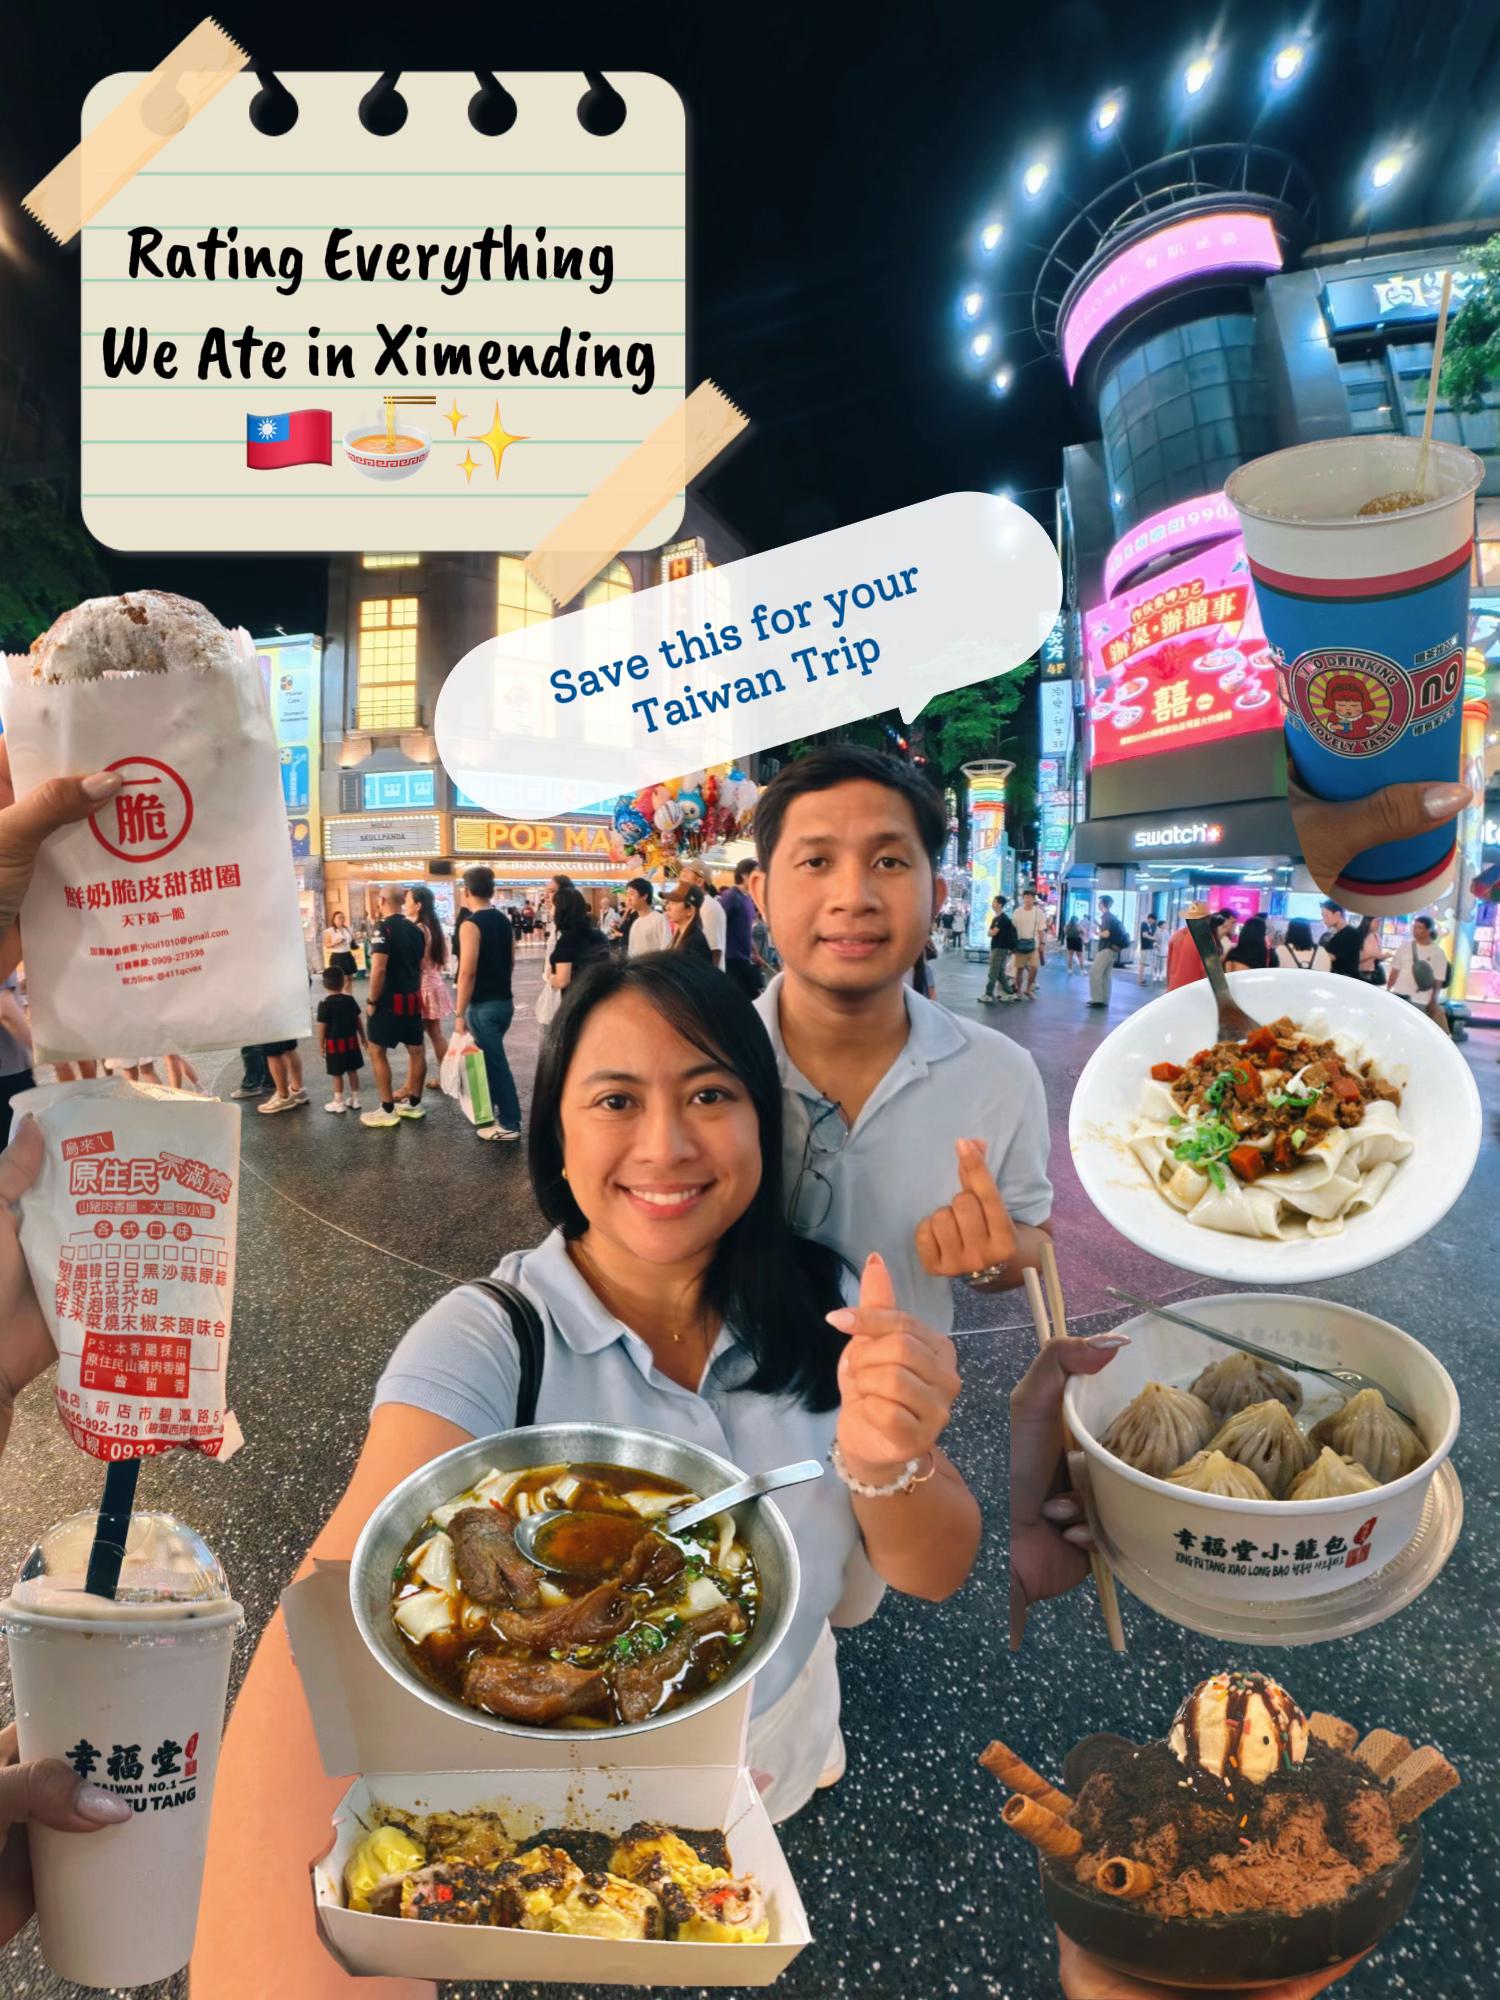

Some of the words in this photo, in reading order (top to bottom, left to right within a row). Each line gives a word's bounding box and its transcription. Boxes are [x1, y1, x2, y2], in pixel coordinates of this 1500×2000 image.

[1326, 655, 1400, 687] DRINKING
[1420, 661, 1460, 709] no
[1309, 720, 1354, 752] LOVELY
[1361, 723, 1399, 751] TASTE
[489, 823, 553, 851] POP
[564, 827, 613, 852] MA
[1135, 824, 1208, 847] swatch
[64, 863, 241, 911] 鮮奶脆皮甜甜圈
[121, 907, 186, 928] 天下第一脆
[95, 1220, 192, 1241] 各式口味
[84, 1352, 187, 1376] 原住民山豬肉香腸
[95, 1400, 225, 1424] 新店市碧潭路5
[1174, 1528, 1348, 1562] 幸福堂小籠包
[1175, 1552, 1193, 1568] XING
[1194, 1556, 1204, 1568] FU
[1205, 1558, 1226, 1574] TANG
[1227, 1564, 1246, 1576] XIAO
[1248, 1564, 1271, 1577] LONG
[1272, 1563, 1290, 1577] BAO
[65, 1738, 183, 1782] 幸福堂
[148, 1780, 176, 1793] NO.1
[150, 1786, 196, 1811] TANG
